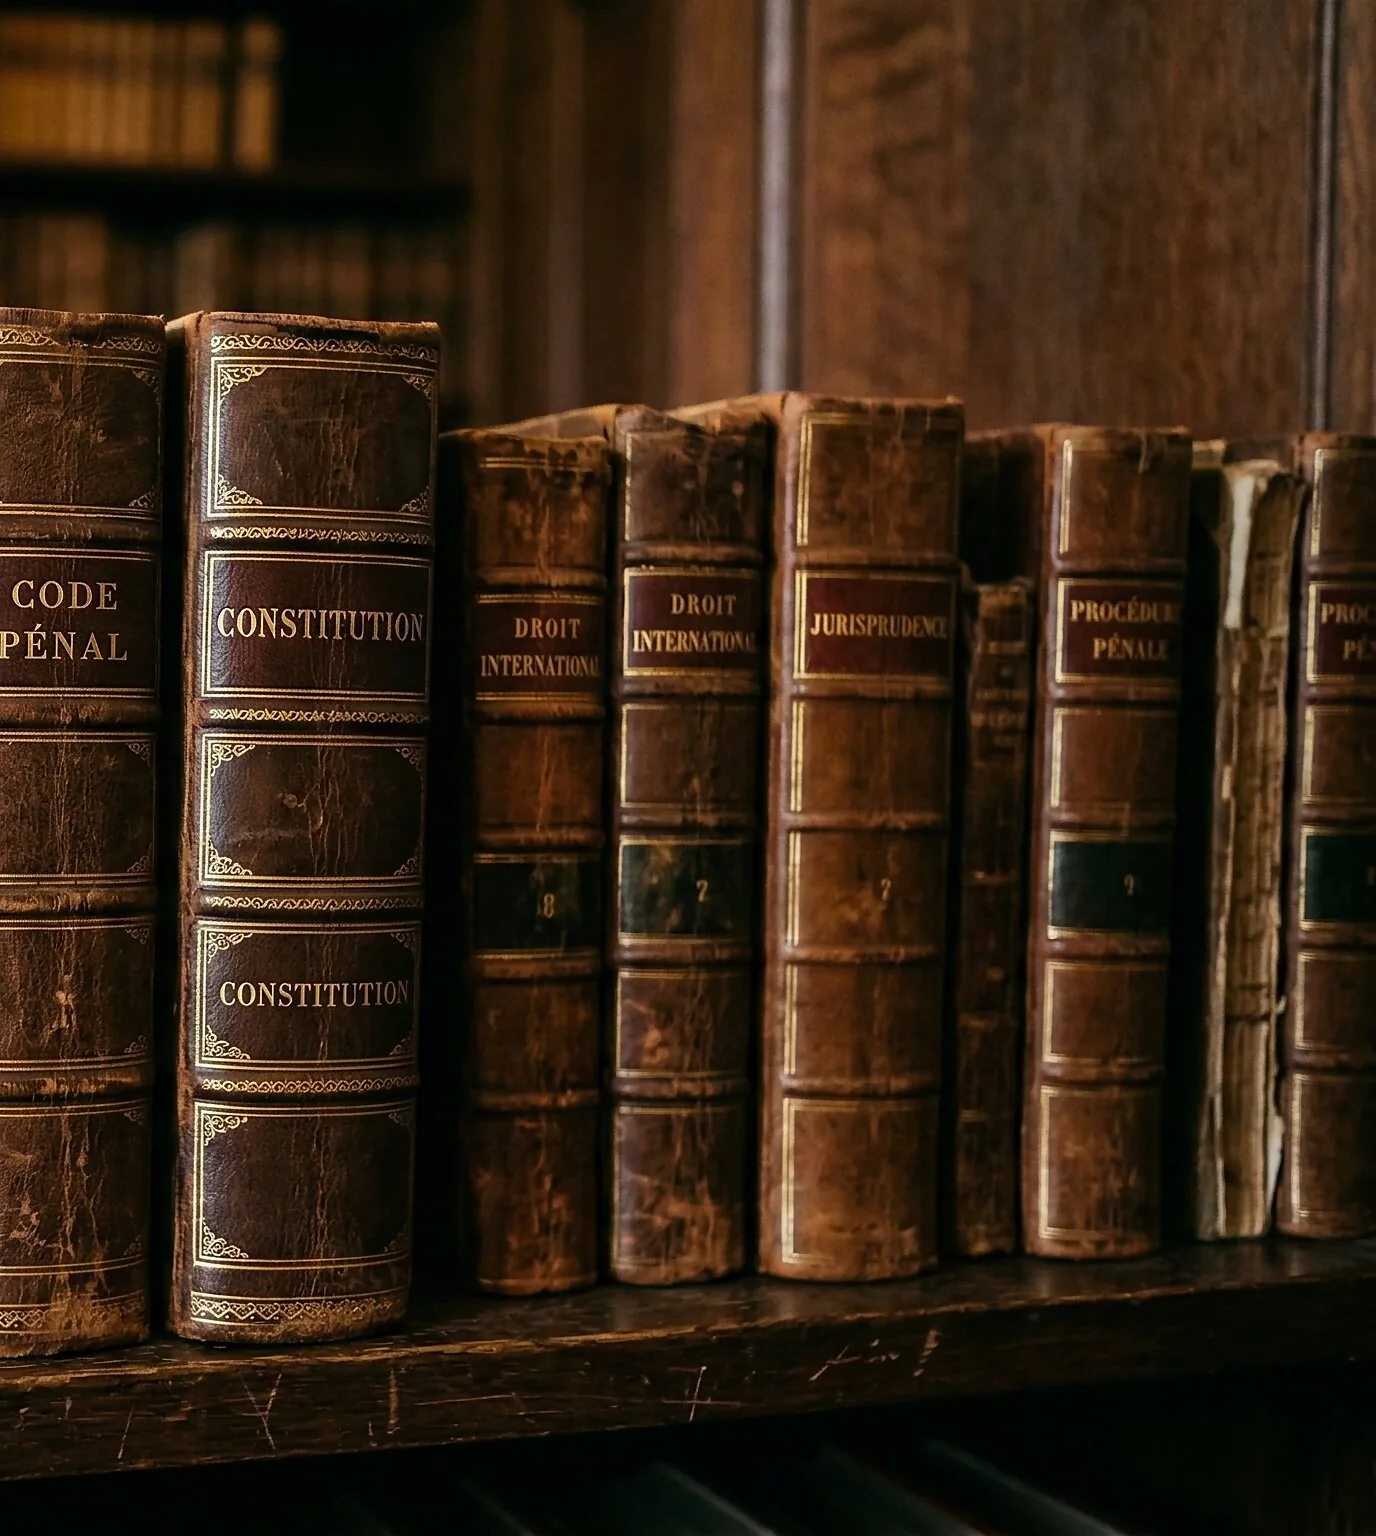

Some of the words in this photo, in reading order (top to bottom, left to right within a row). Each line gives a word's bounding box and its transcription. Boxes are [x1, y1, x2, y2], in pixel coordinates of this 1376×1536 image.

[11, 579, 118, 610] CODE
[670, 593, 737, 616] DROIT
[217, 607, 424, 642] CONSTITUTION
[514, 617, 581, 639] DROIT
[810, 613, 948, 638] JURISPRUDENCE
[219, 980, 409, 1007] CONSTITUTION
